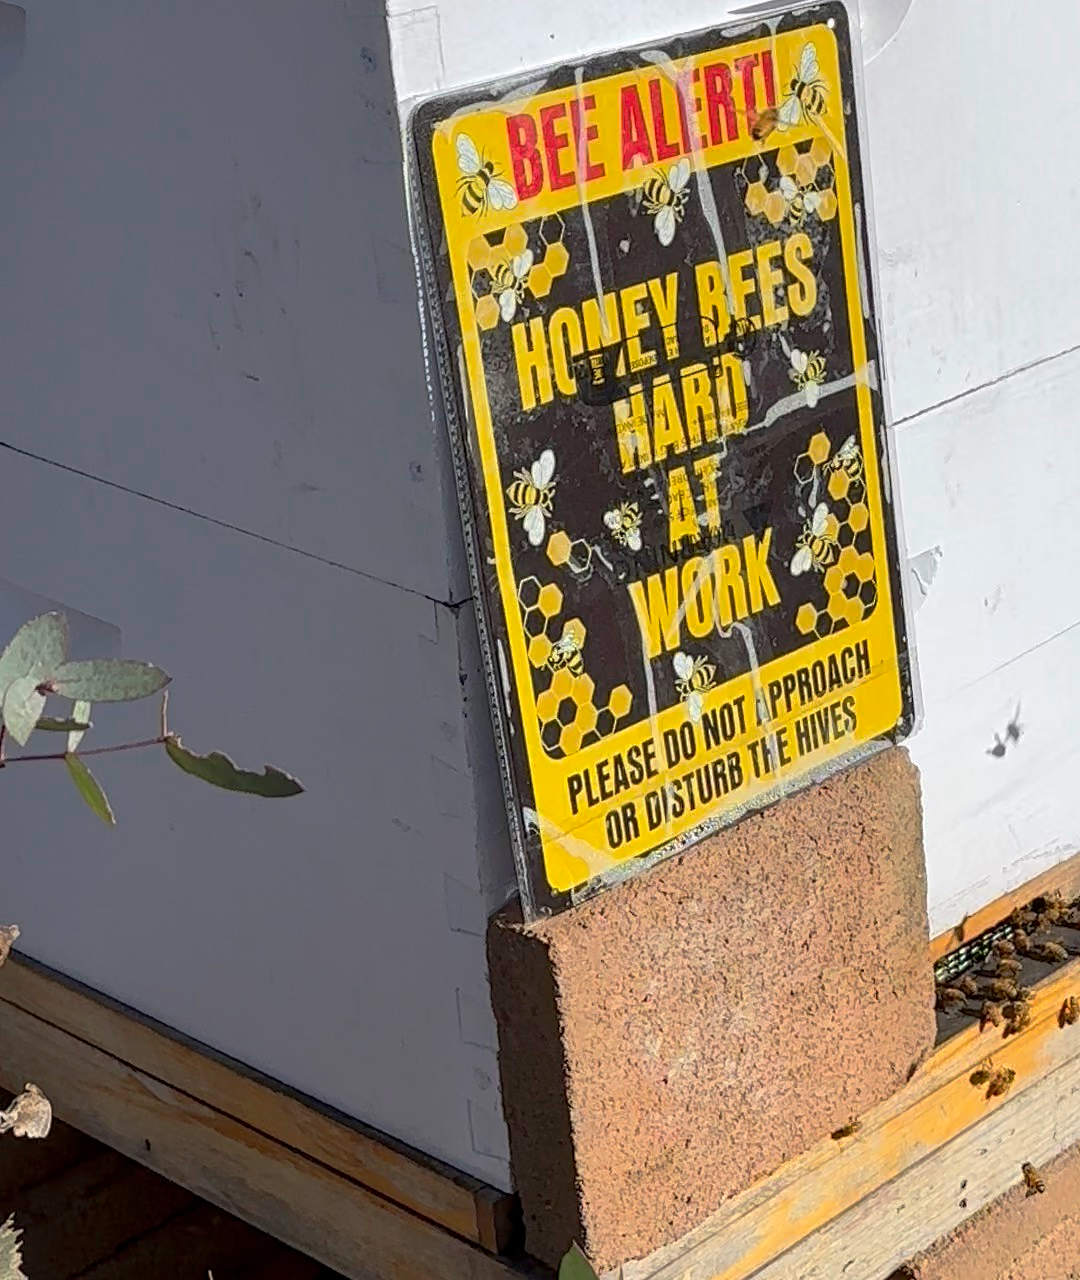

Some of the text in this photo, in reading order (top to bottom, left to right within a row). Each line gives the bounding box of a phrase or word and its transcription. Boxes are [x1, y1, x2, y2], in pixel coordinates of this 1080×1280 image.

[506, 95, 605, 201] BEE
[511, 233, 817, 411] HONEY BEES
[612, 351, 749, 474] HARD
[668, 454, 722, 553] AT
[628, 526, 781, 659] WORK
[567, 639, 872, 816] PLEASE DO NOT APPROACH
[604, 695, 858, 850] OR DISTURB THE HIVES
